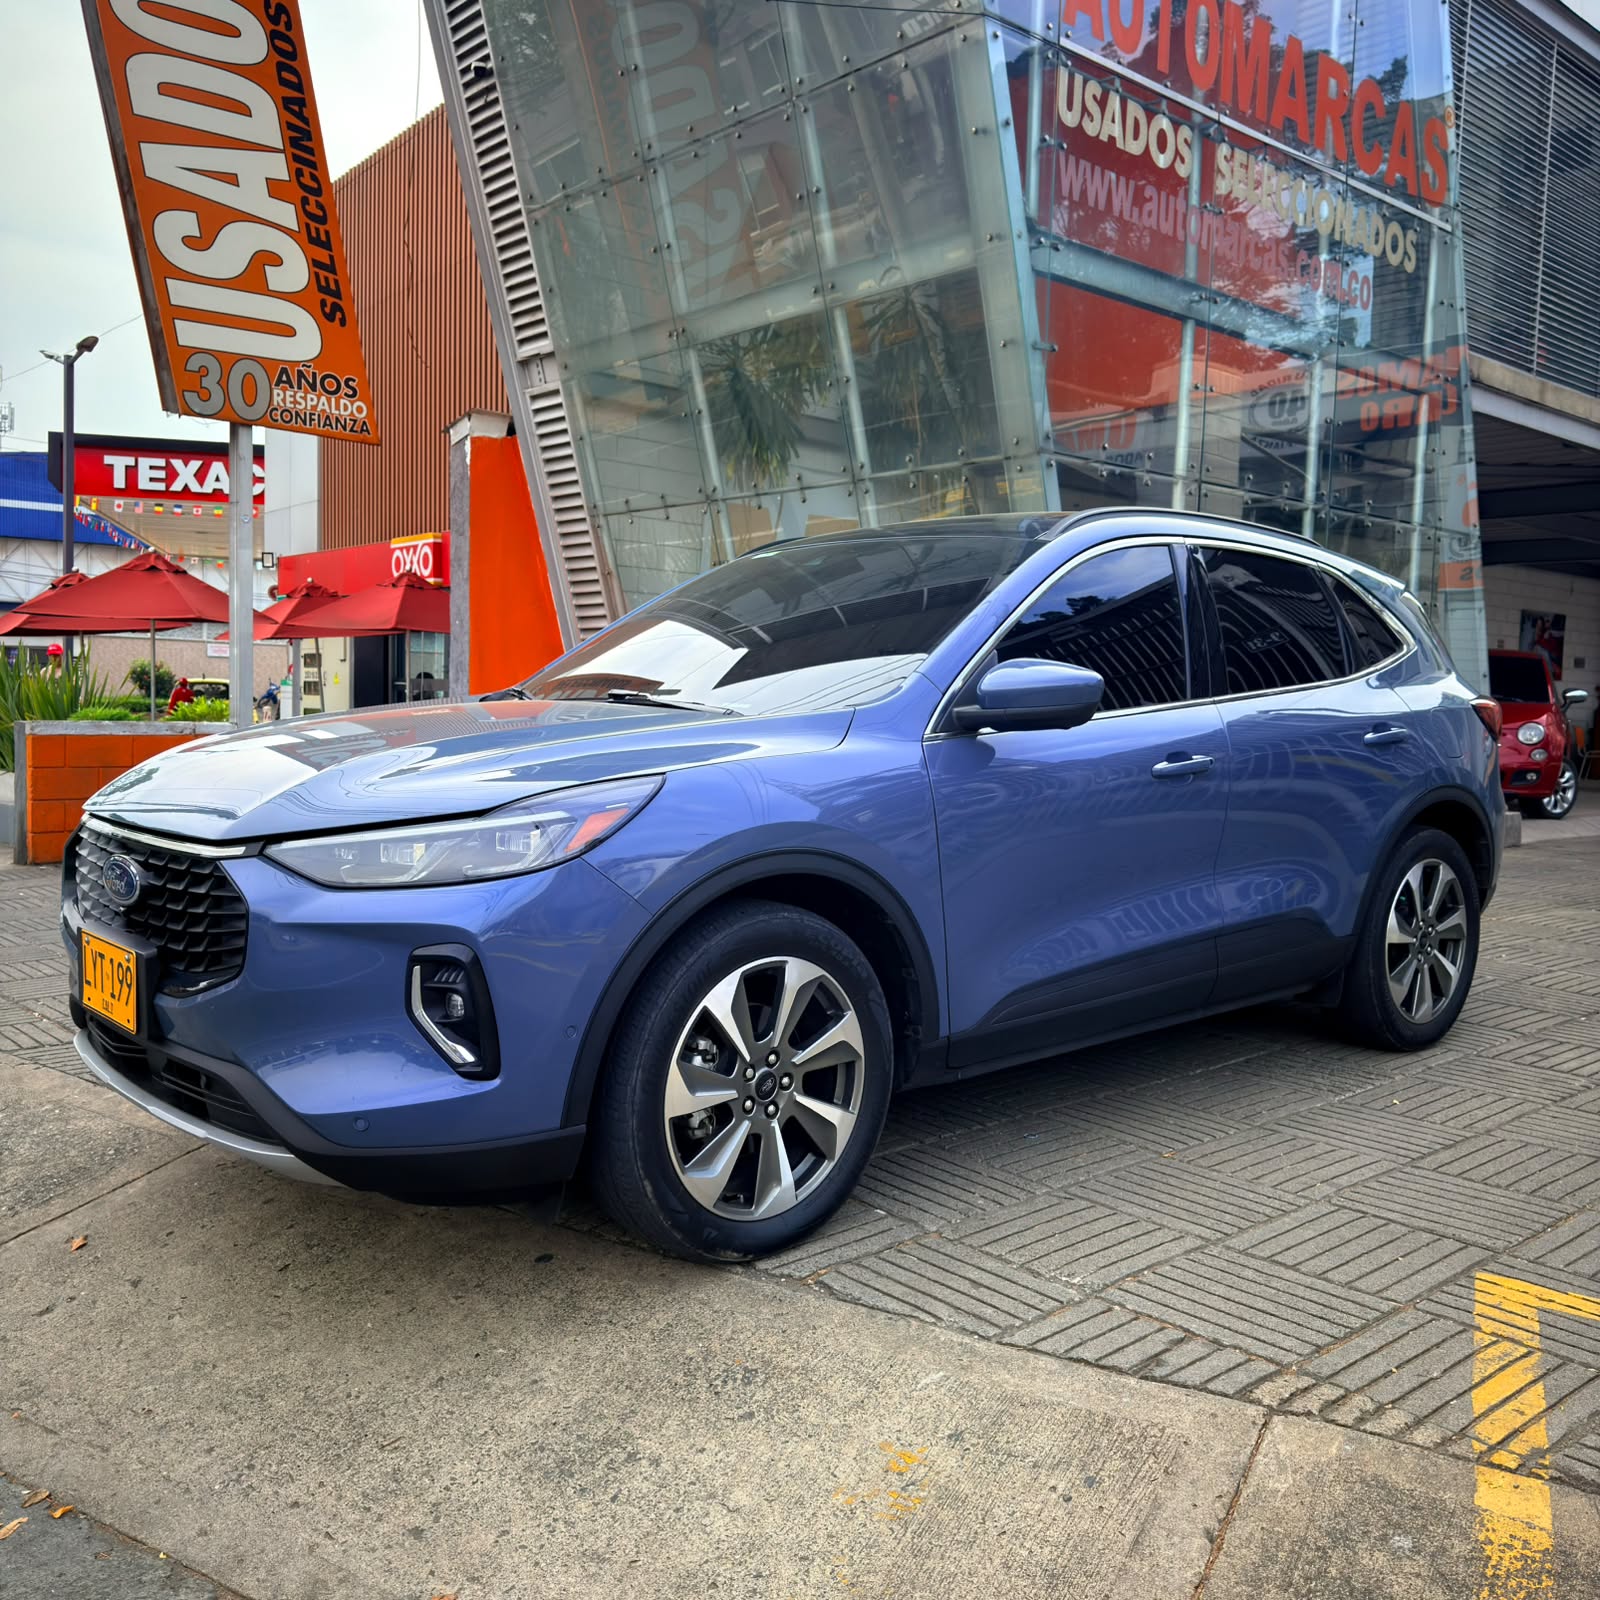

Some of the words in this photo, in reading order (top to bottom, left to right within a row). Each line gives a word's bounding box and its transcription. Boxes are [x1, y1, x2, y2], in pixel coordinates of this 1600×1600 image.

[1058, 66, 1194, 178] USADOS
[1215, 142, 1418, 274] SELECCIONADOS
[183, 352, 271, 421] 30
[273, 363, 359, 400] AÑOS
[272, 389, 368, 419] RESPALDO
[268, 406, 372, 436] CONFIANZA
[391, 542, 433, 578] OXXO
